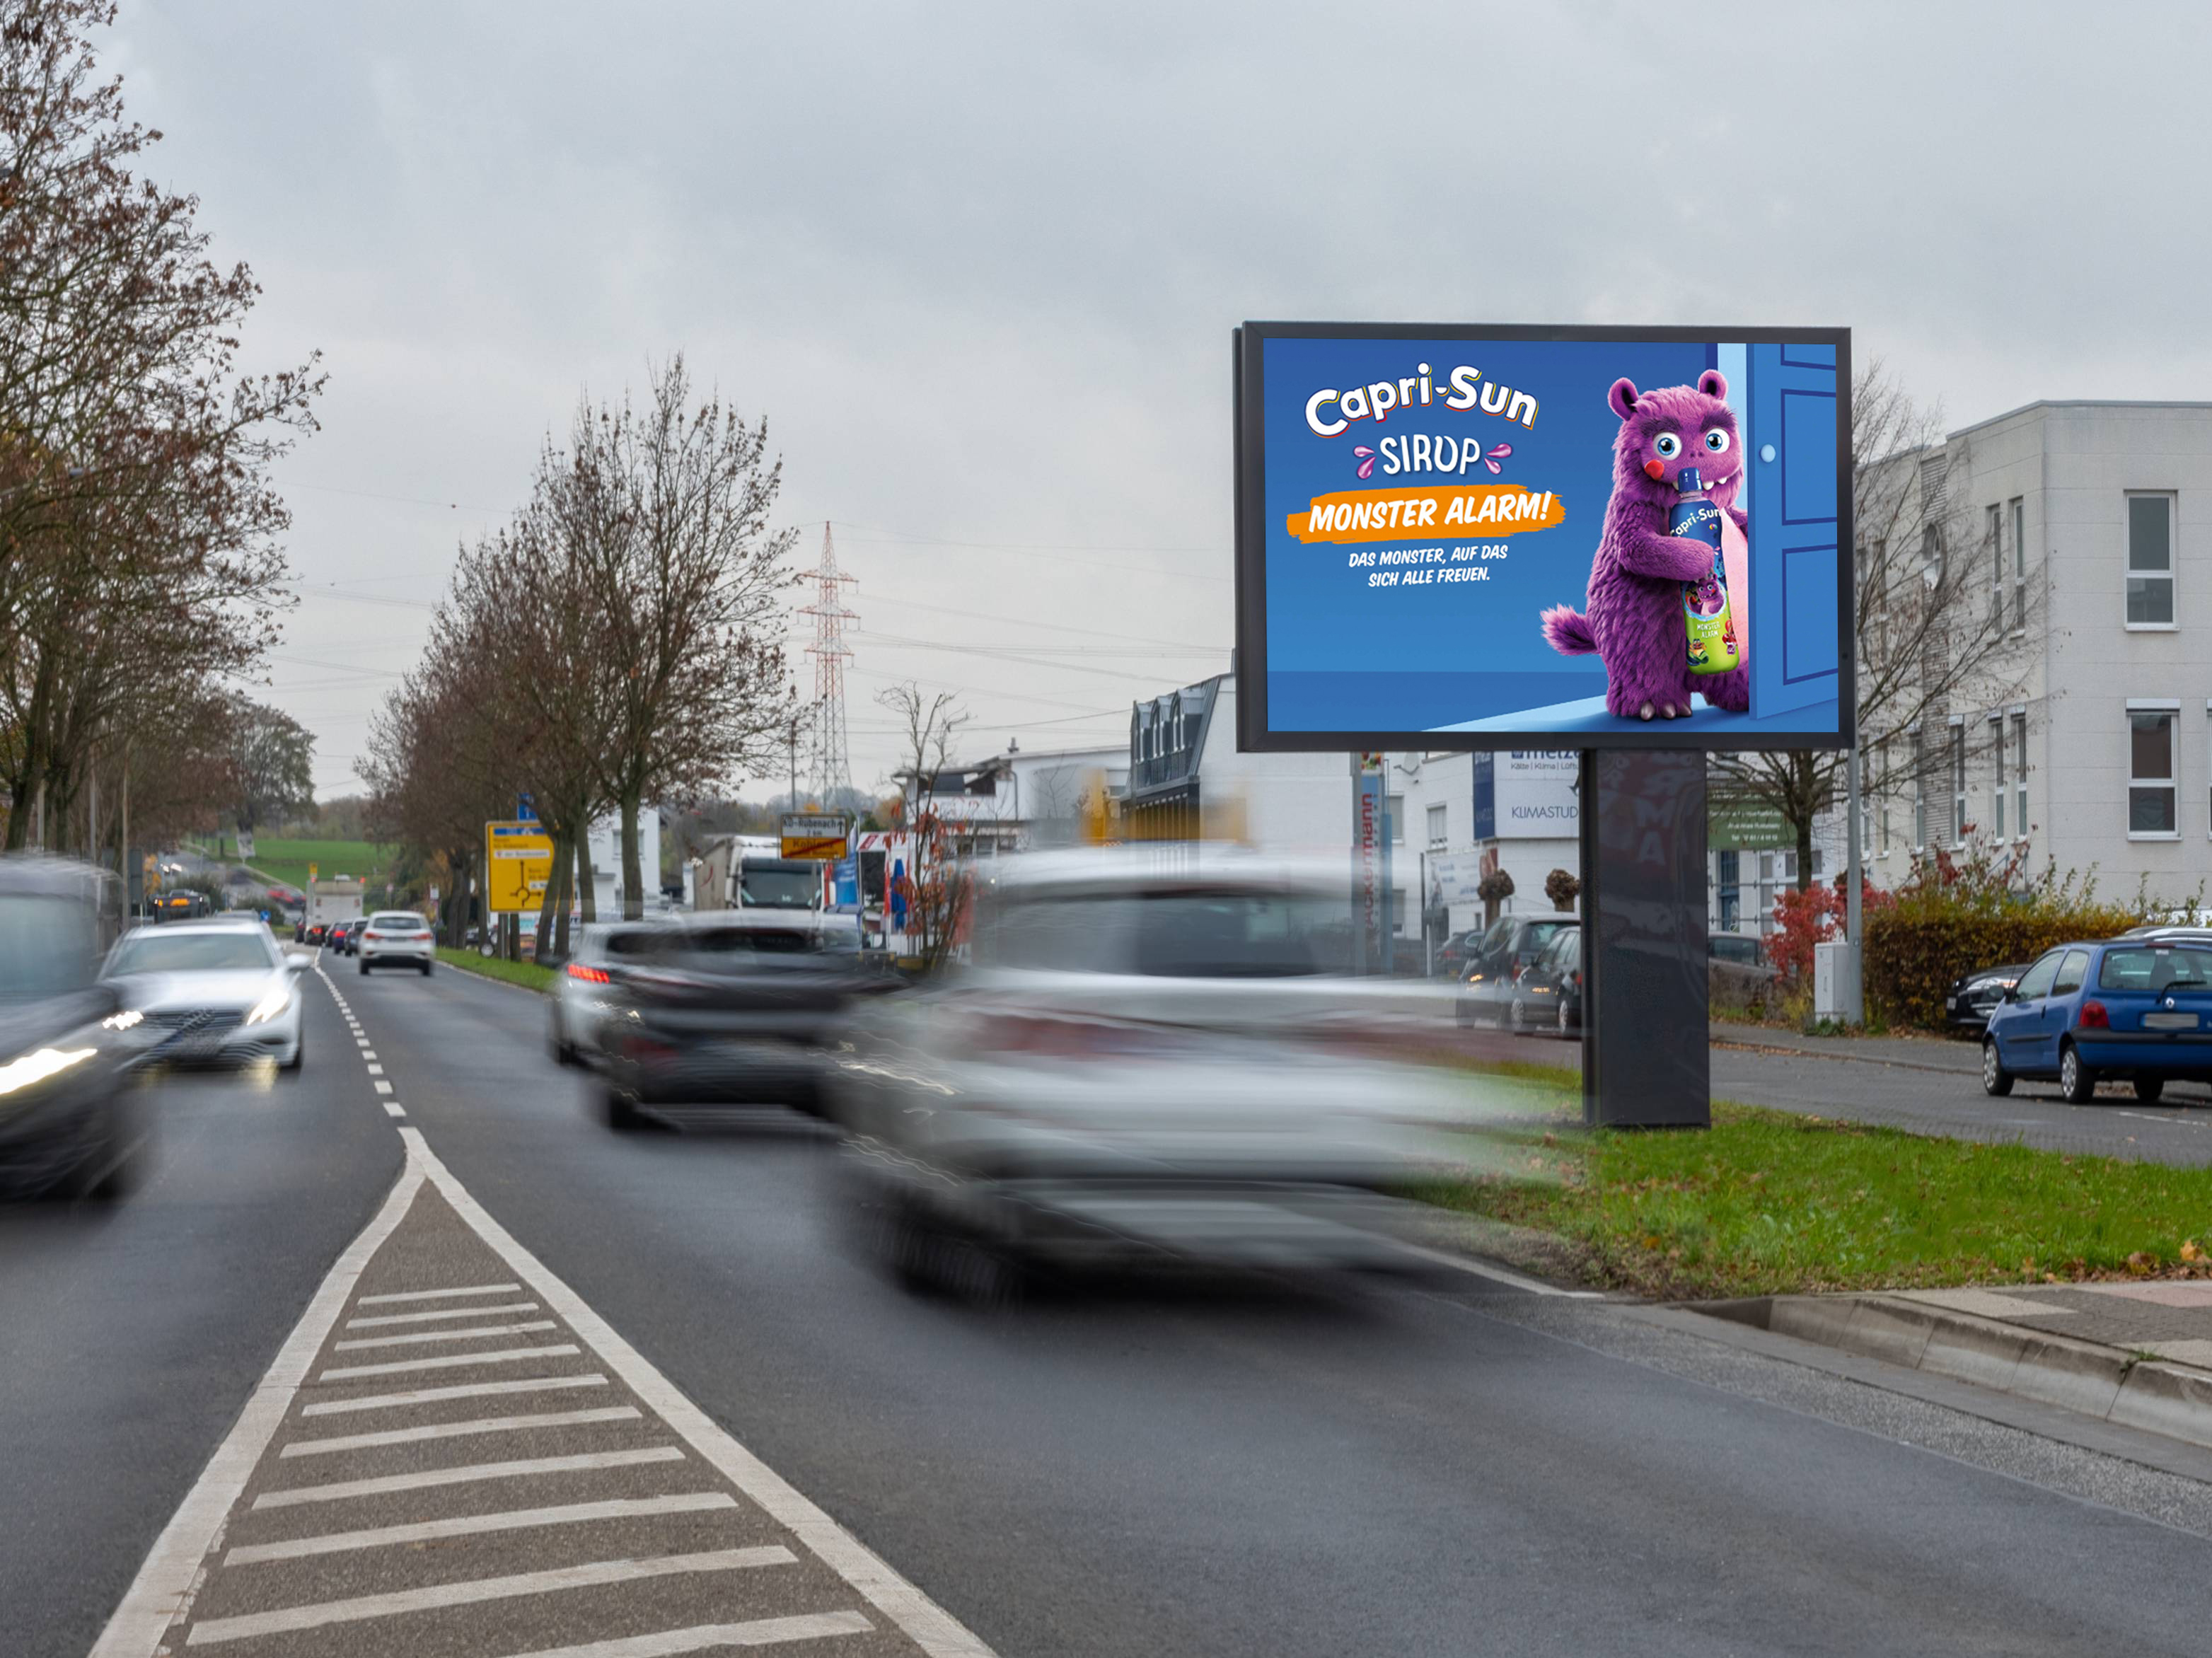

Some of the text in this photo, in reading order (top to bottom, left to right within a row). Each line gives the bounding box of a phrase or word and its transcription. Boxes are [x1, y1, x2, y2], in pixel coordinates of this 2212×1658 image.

[1305, 362, 1539, 439] Capri-Sun
[1309, 490, 1553, 533] MONSTER ALARM!
[1348, 544, 1509, 568] DAS MONSTER, AUF DAS
[1367, 566, 1491, 588] SICH ALLE FREUEN.
[1511, 806, 1579, 819] KLIMASTUD
